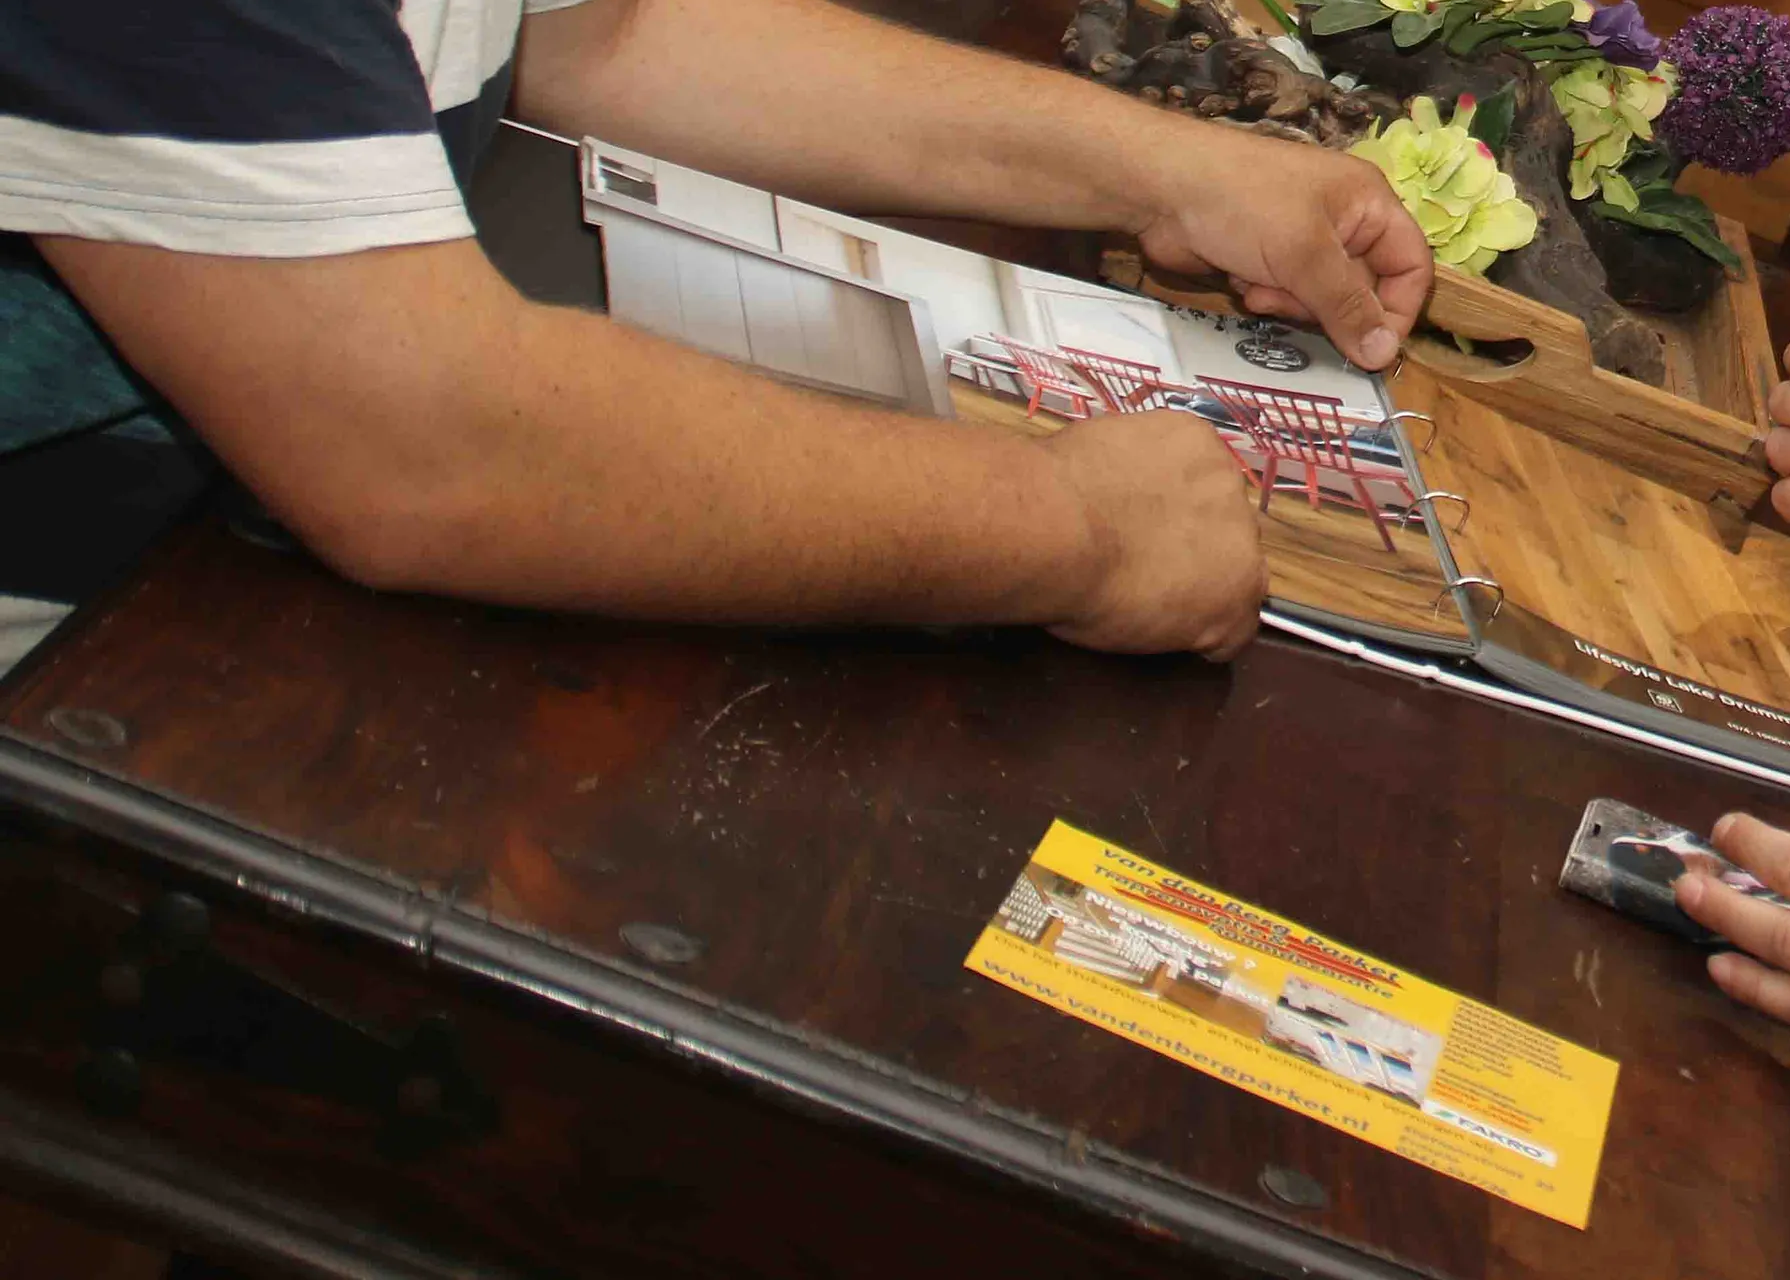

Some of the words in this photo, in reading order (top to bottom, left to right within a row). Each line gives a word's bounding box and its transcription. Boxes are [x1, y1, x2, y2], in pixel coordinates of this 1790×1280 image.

[1574, 639, 1662, 683] Lifestyle
[1665, 675, 1716, 702] Lake
[1084, 889, 1237, 963] Nieuwbouw
[1104, 848, 1156, 878] van
[1161, 876, 1217, 906] den
[1221, 901, 1292, 937] Berg
[1304, 935, 1401, 983] Parket
[982, 959, 1371, 1133] www.vandenbergparket.nl
[1457, 1117, 1544, 1159] FAKRO
